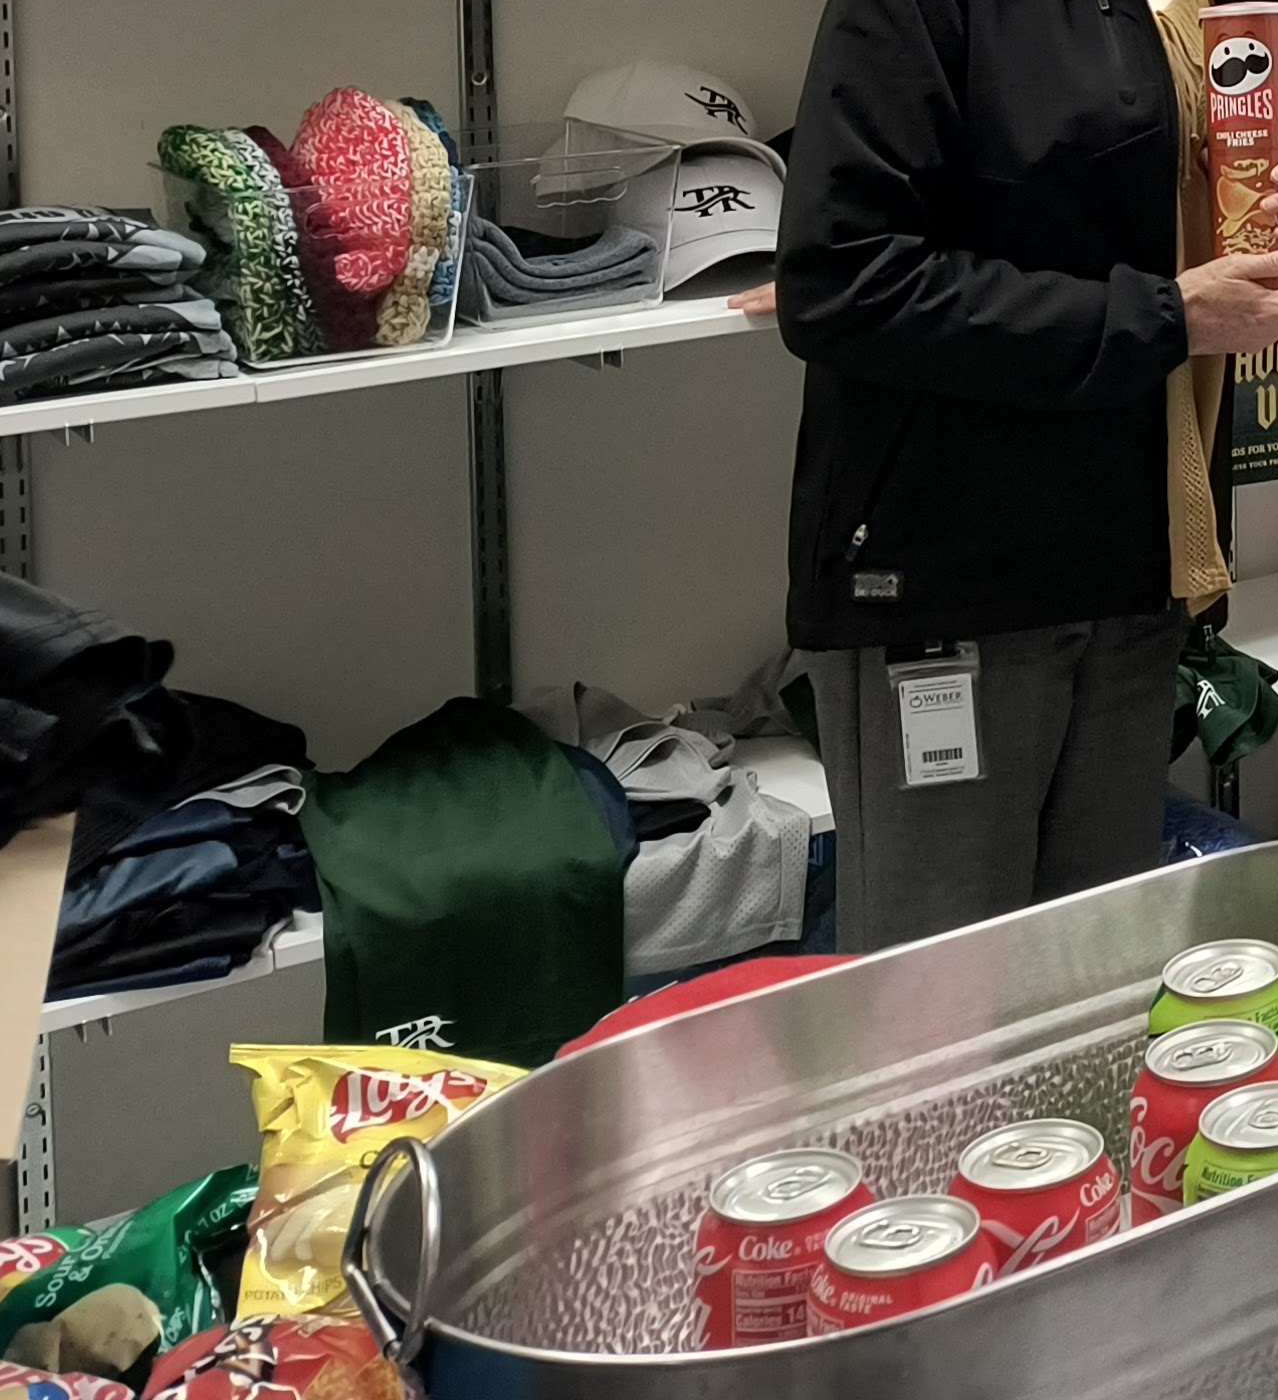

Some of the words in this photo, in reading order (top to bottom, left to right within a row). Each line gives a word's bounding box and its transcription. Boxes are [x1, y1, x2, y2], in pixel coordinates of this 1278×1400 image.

[1210, 88, 1274, 124] PRINGLES
[1227, 138, 1254, 147] FRIES
[1235, 129, 1268, 139] CHEESE
[1247, 443, 1266, 455] FOR
[1248, 460, 1268, 469] YOUR
[923, 691, 962, 702] WEBER
[328, 1069, 487, 1133] Lay's
[1201, 1166, 1244, 1186] Nutrition
[1079, 1171, 1115, 1207] Coke
[210, 1202, 234, 1224] OZ
[738, 1235, 794, 1261] Coke
[34, 1253, 79, 1309] Sour
[68, 1264, 92, 1283] &
[735, 1274, 782, 1288] Nutrition
[810, 1263, 836, 1303] Coke
[244, 1287, 287, 1301] POTAT
[308, 1279, 343, 1295] HIPS
[840, 1291, 893, 1306] ORIGINAL
[735, 1313, 783, 1327] Calories
[786, 1304, 806, 1322] 14
[839, 1301, 872, 1315] TASTE
